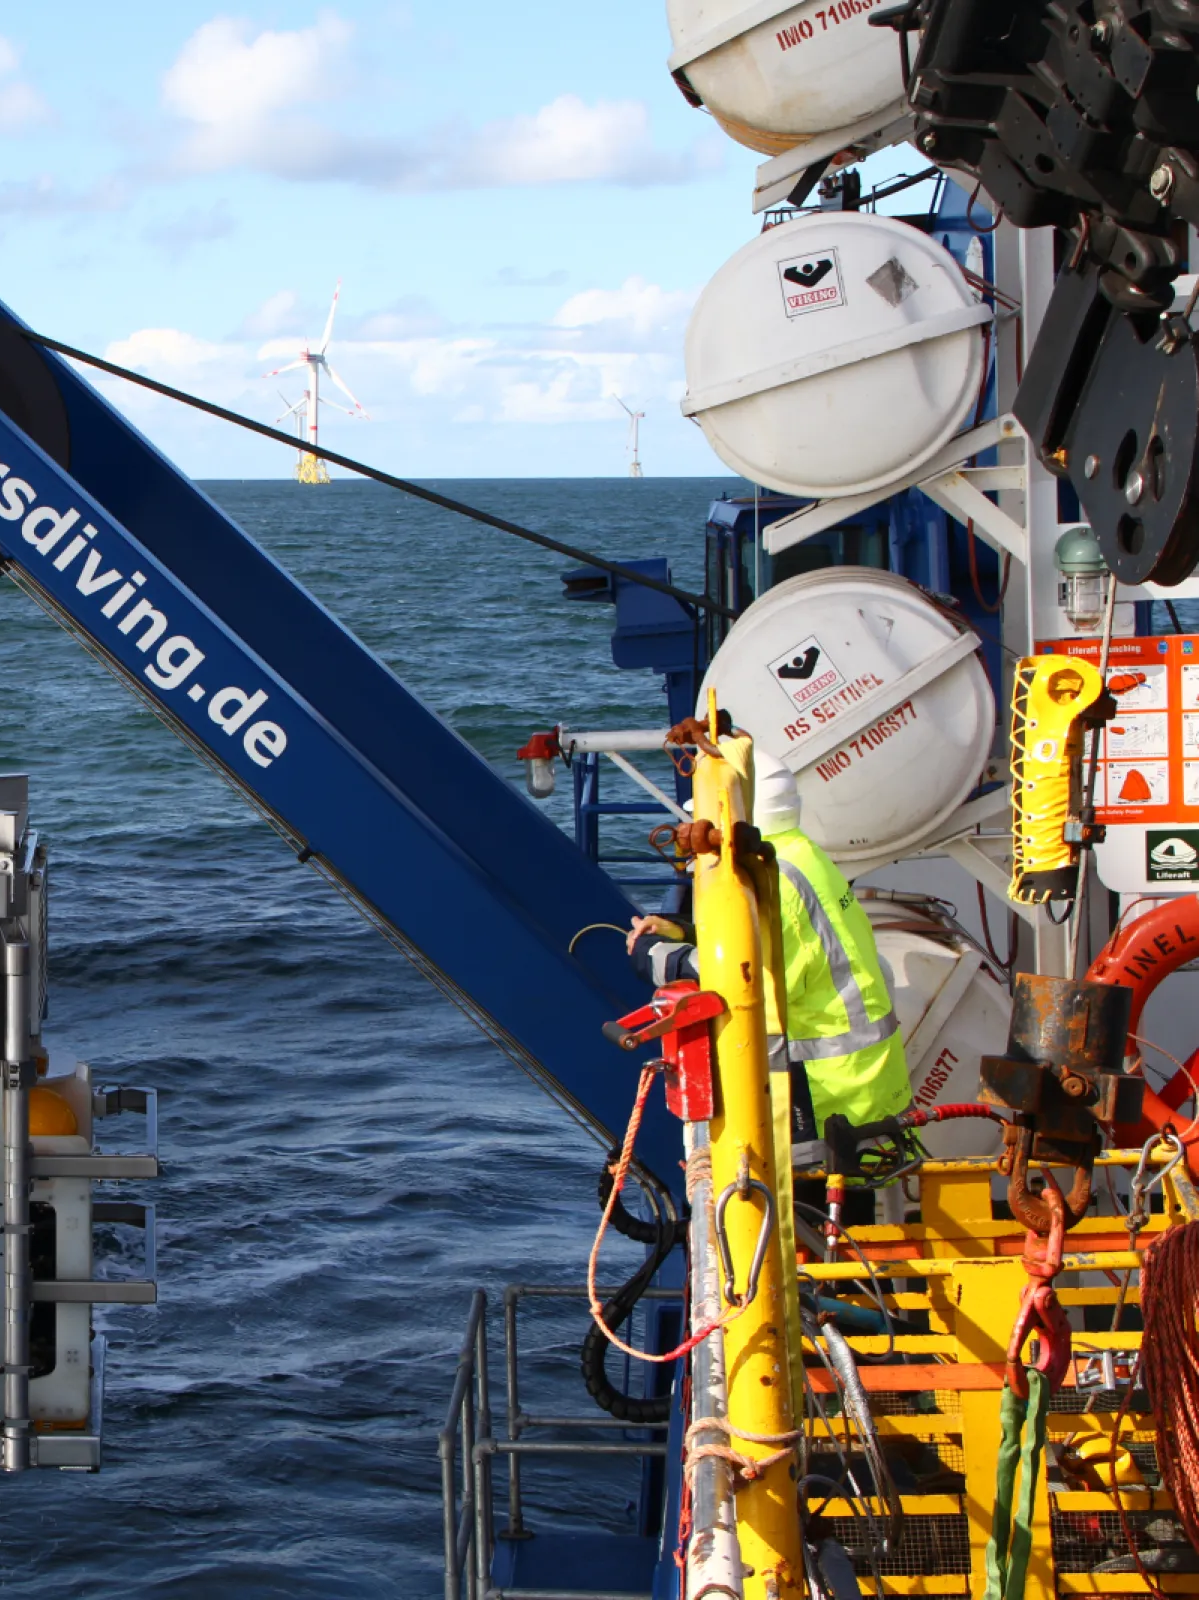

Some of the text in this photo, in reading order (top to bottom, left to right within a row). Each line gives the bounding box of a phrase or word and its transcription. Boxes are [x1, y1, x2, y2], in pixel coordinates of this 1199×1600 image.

[776, 0, 881, 51] IMO 7106
[787, 286, 837, 308] VIKING
[783, 717, 811, 741] RS
[811, 672, 884, 724] SENTINEL
[793, 670, 837, 702] VIKING
[815, 751, 851, 782] IMO
[1156, 871, 1190, 879] Liferaft
[1115, 924, 1196, 985] INEL
[914, 1048, 959, 1107] 106877
